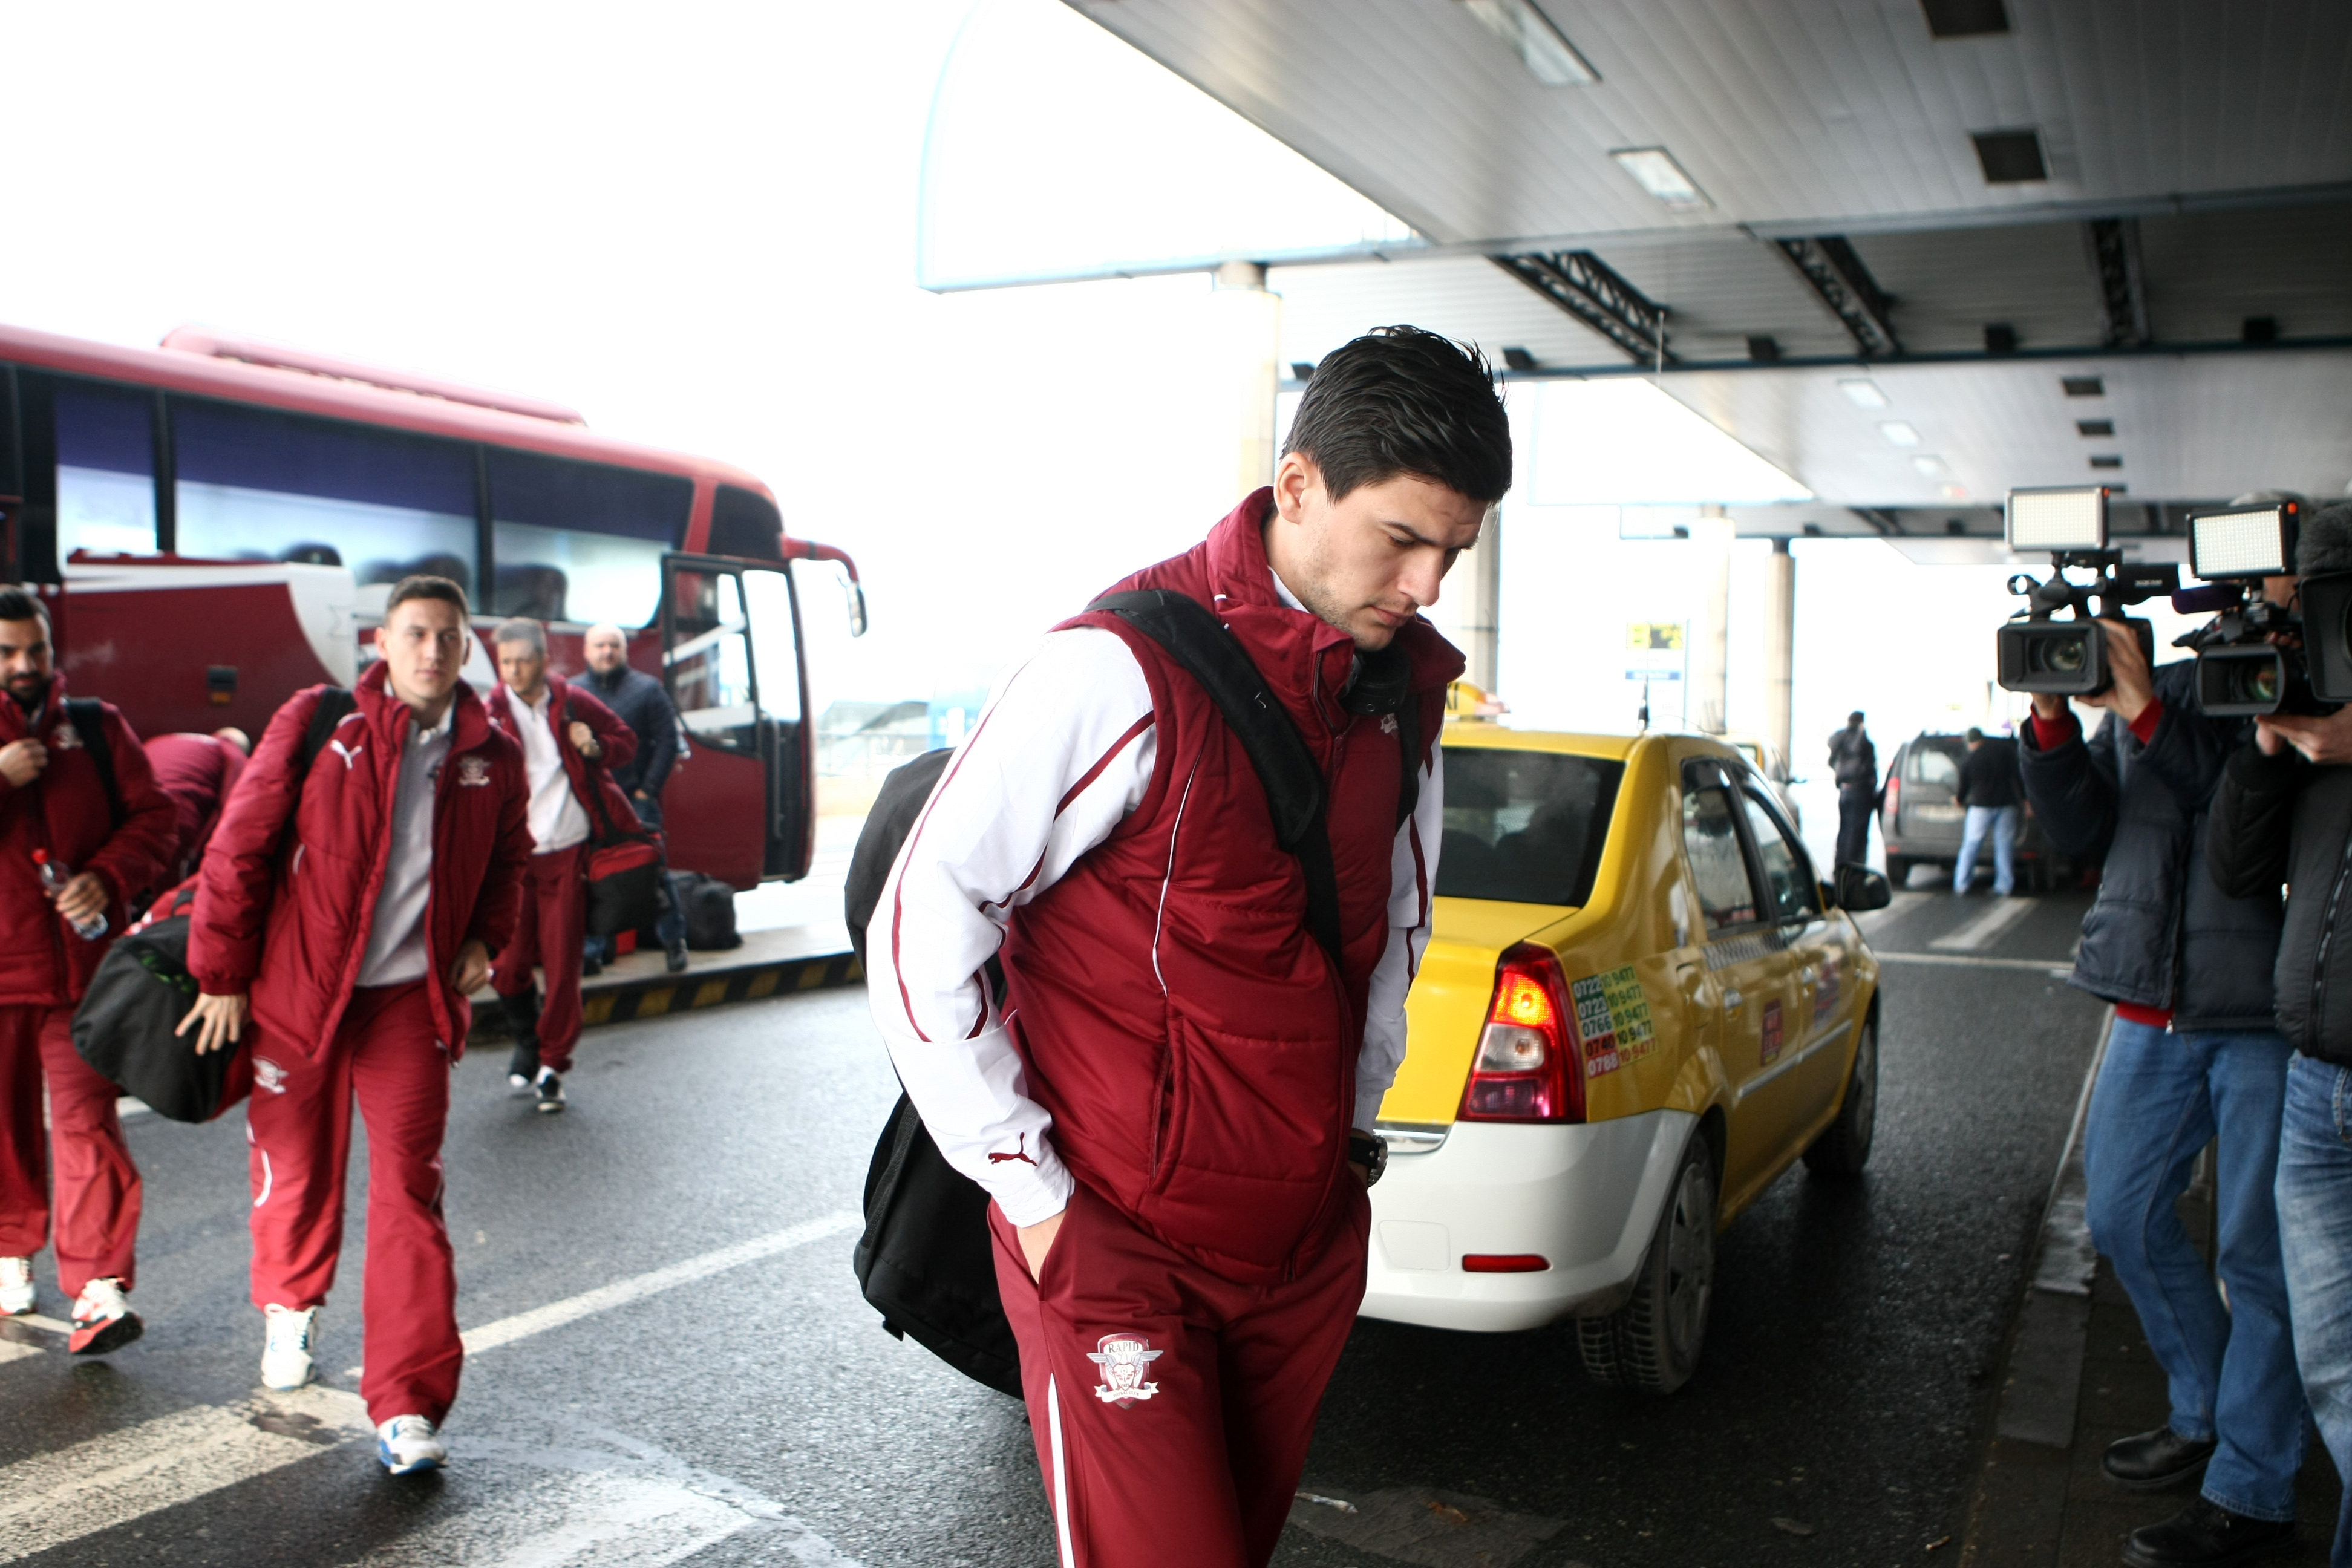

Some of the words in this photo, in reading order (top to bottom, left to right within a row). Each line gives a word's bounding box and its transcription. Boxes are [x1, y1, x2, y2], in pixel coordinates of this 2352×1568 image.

[1573, 976, 1602, 998] 0722
[1602, 974, 1612, 988] 10
[1578, 996, 1607, 1019] 0723
[1608, 993, 1619, 1007] 10
[1582, 1015, 1613, 1037] 0766
[1613, 1011, 1624, 1027] 10
[1586, 1034, 1615, 1057] 0740
[1617, 1030, 1628, 1045] 10
[1587, 1051, 1618, 1076] 0788
[1620, 1048, 1631, 1062] 10
[1108, 1341, 1139, 1353] RAPID
